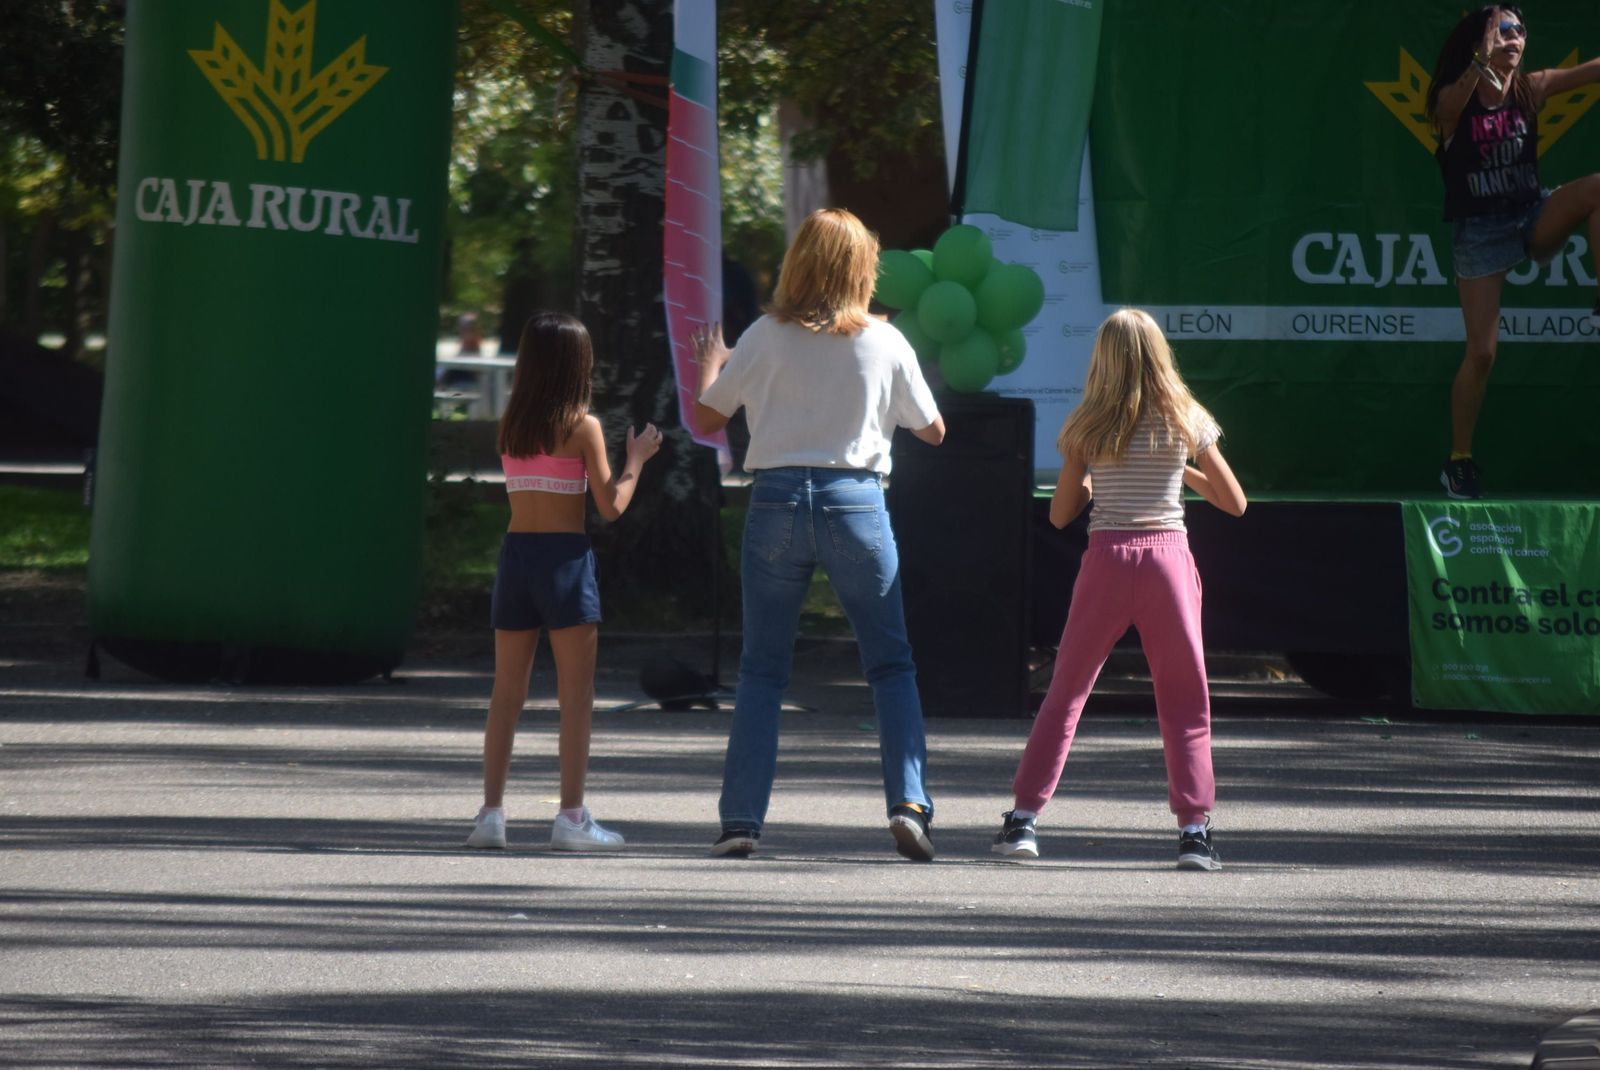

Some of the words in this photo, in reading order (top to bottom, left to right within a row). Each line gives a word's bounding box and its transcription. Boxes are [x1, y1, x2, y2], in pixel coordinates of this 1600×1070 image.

[1471, 109, 1528, 142] NEVER
[1479, 138, 1525, 168] STOP
[135, 176, 241, 226] CAJA
[246, 183, 419, 244] RURAL
[1292, 232, 1448, 288] CAJA
[1165, 309, 1232, 334] LEÓN
[1292, 313, 1416, 336] OURENSE
[1498, 315, 1600, 337] ALLADO
[518, 478, 543, 490] LOVE
[547, 480, 576, 492] LOVE
[1432, 577, 1533, 605] Contra
[1539, 583, 1570, 608] el
[1432, 611, 1531, 635] somos
